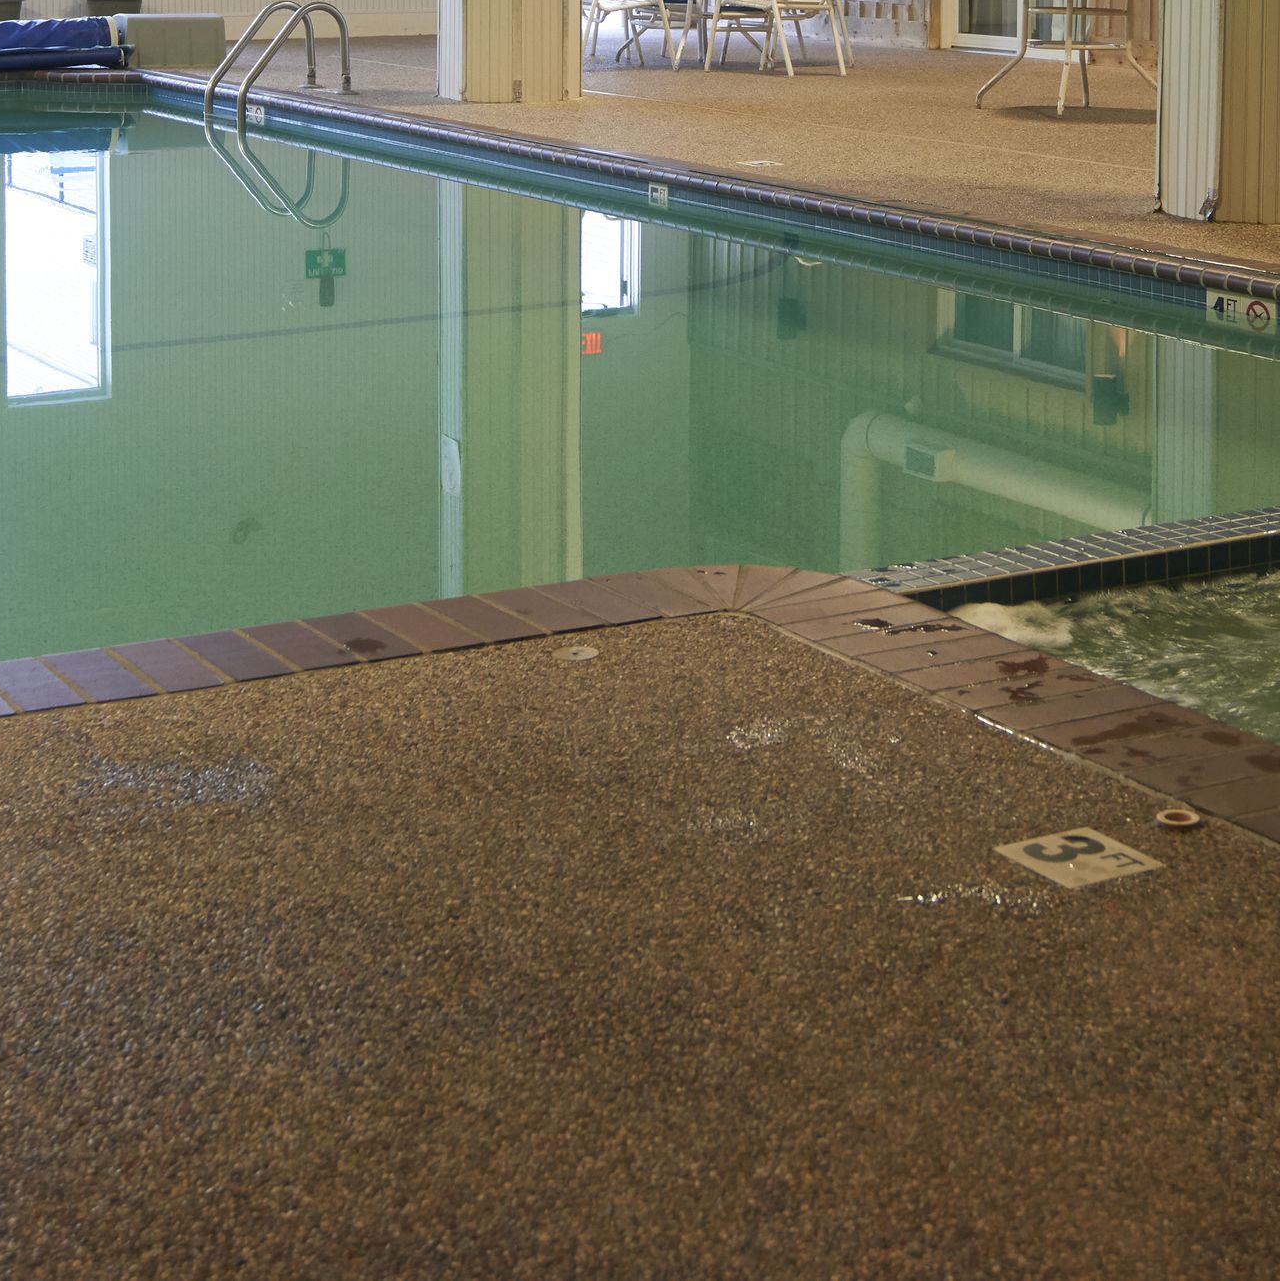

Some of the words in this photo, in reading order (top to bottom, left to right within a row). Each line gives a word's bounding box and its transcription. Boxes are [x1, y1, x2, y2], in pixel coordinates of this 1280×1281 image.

[1226, 298, 1238, 312] FT
[1023, 835, 1106, 863] 3
[1099, 852, 1147, 868] FT
